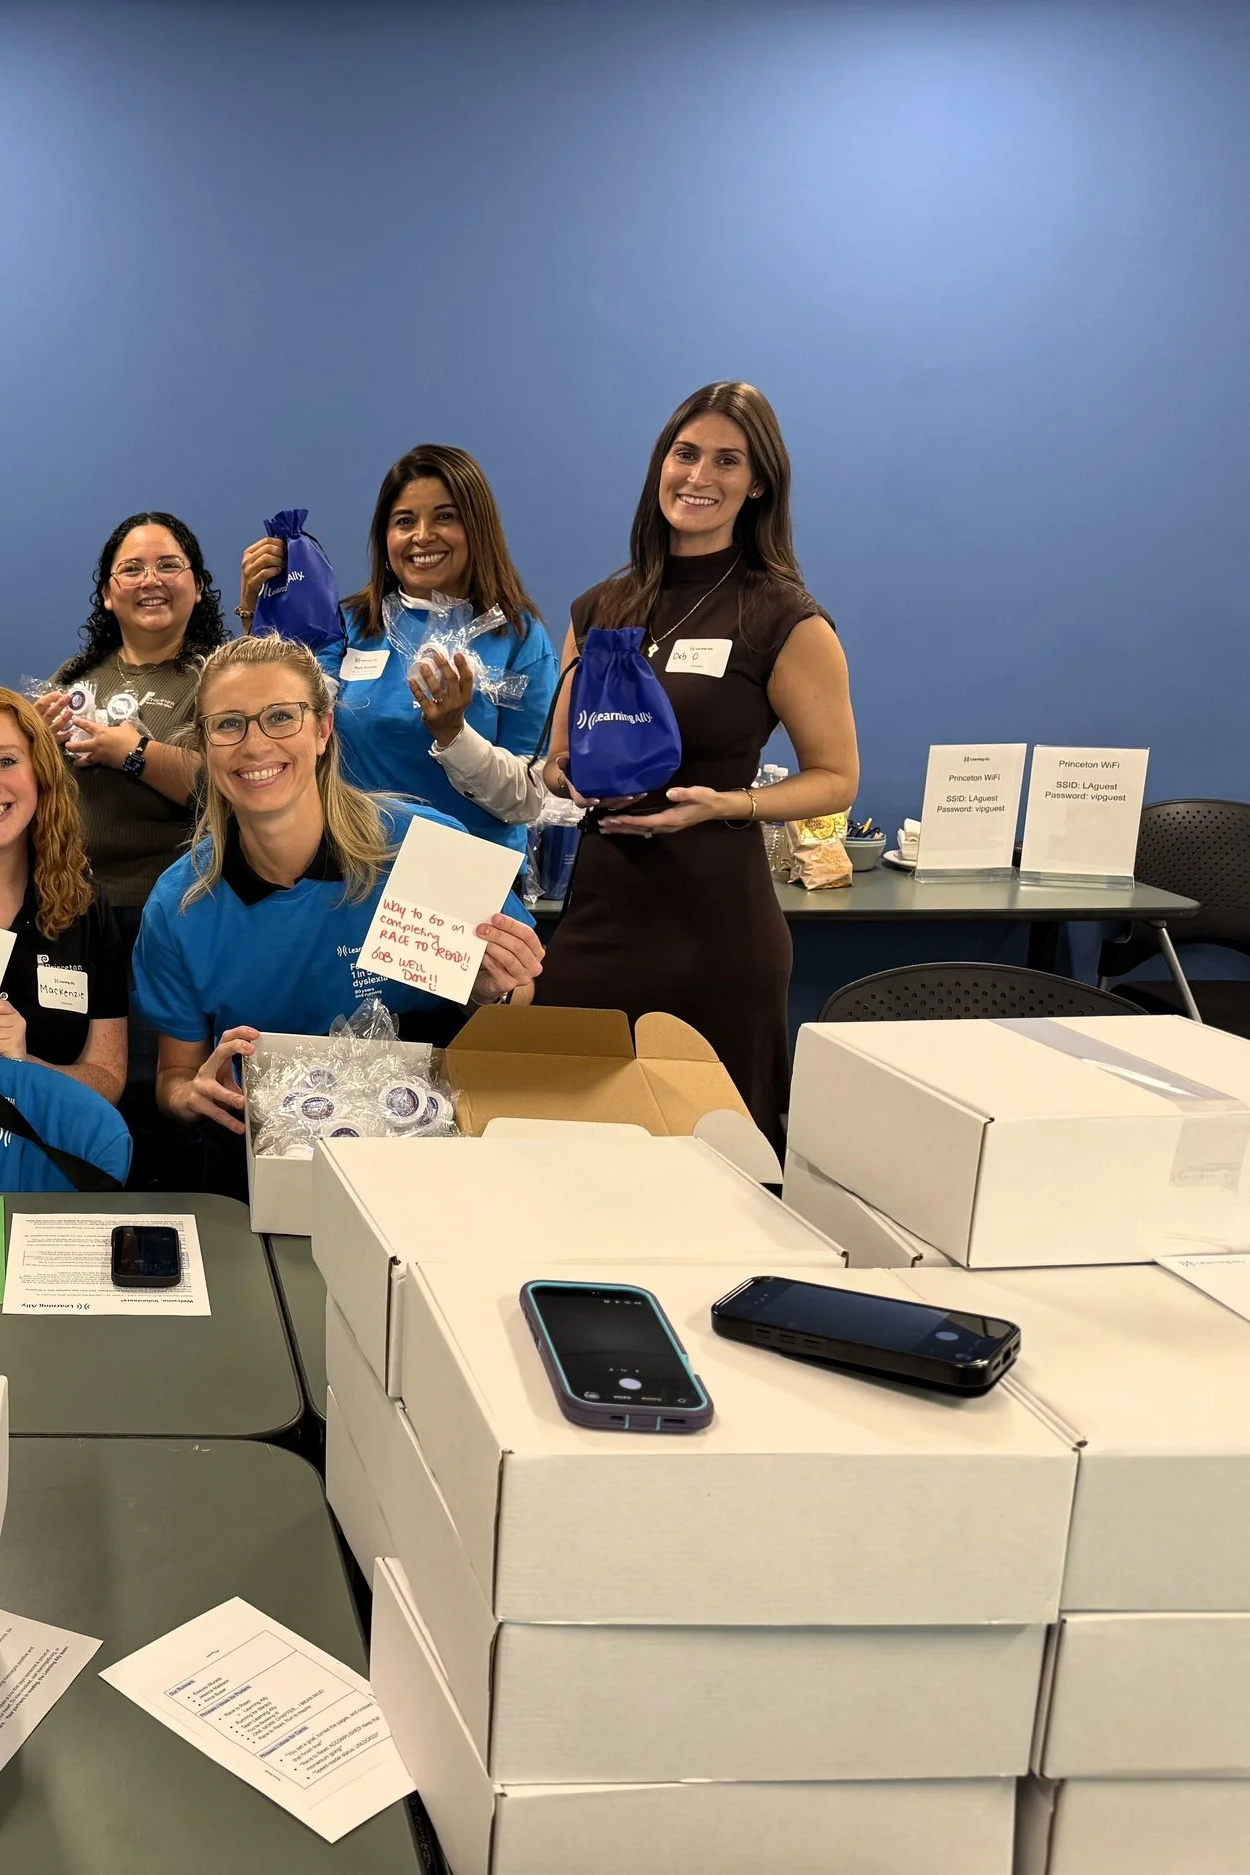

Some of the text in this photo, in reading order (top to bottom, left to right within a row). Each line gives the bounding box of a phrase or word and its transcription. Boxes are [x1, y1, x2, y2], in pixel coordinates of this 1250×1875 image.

[1059, 760, 1120, 769] Princeton WiFi
[1056, 781, 1118, 791] SSID: LAguest
[968, 795, 998, 803] LAguest
[1045, 791, 1126, 802] Password: vipguest
[937, 805, 1005, 813] Password: vipguest
[411, 908, 423, 920] to
[451, 924, 465, 935] on
[379, 929, 410, 947] RACE
[415, 940, 429, 952] TO
[242, 1700, 261, 1712] Learning
[235, 1713, 253, 1725] Running
[251, 1710, 270, 1722] Learning
